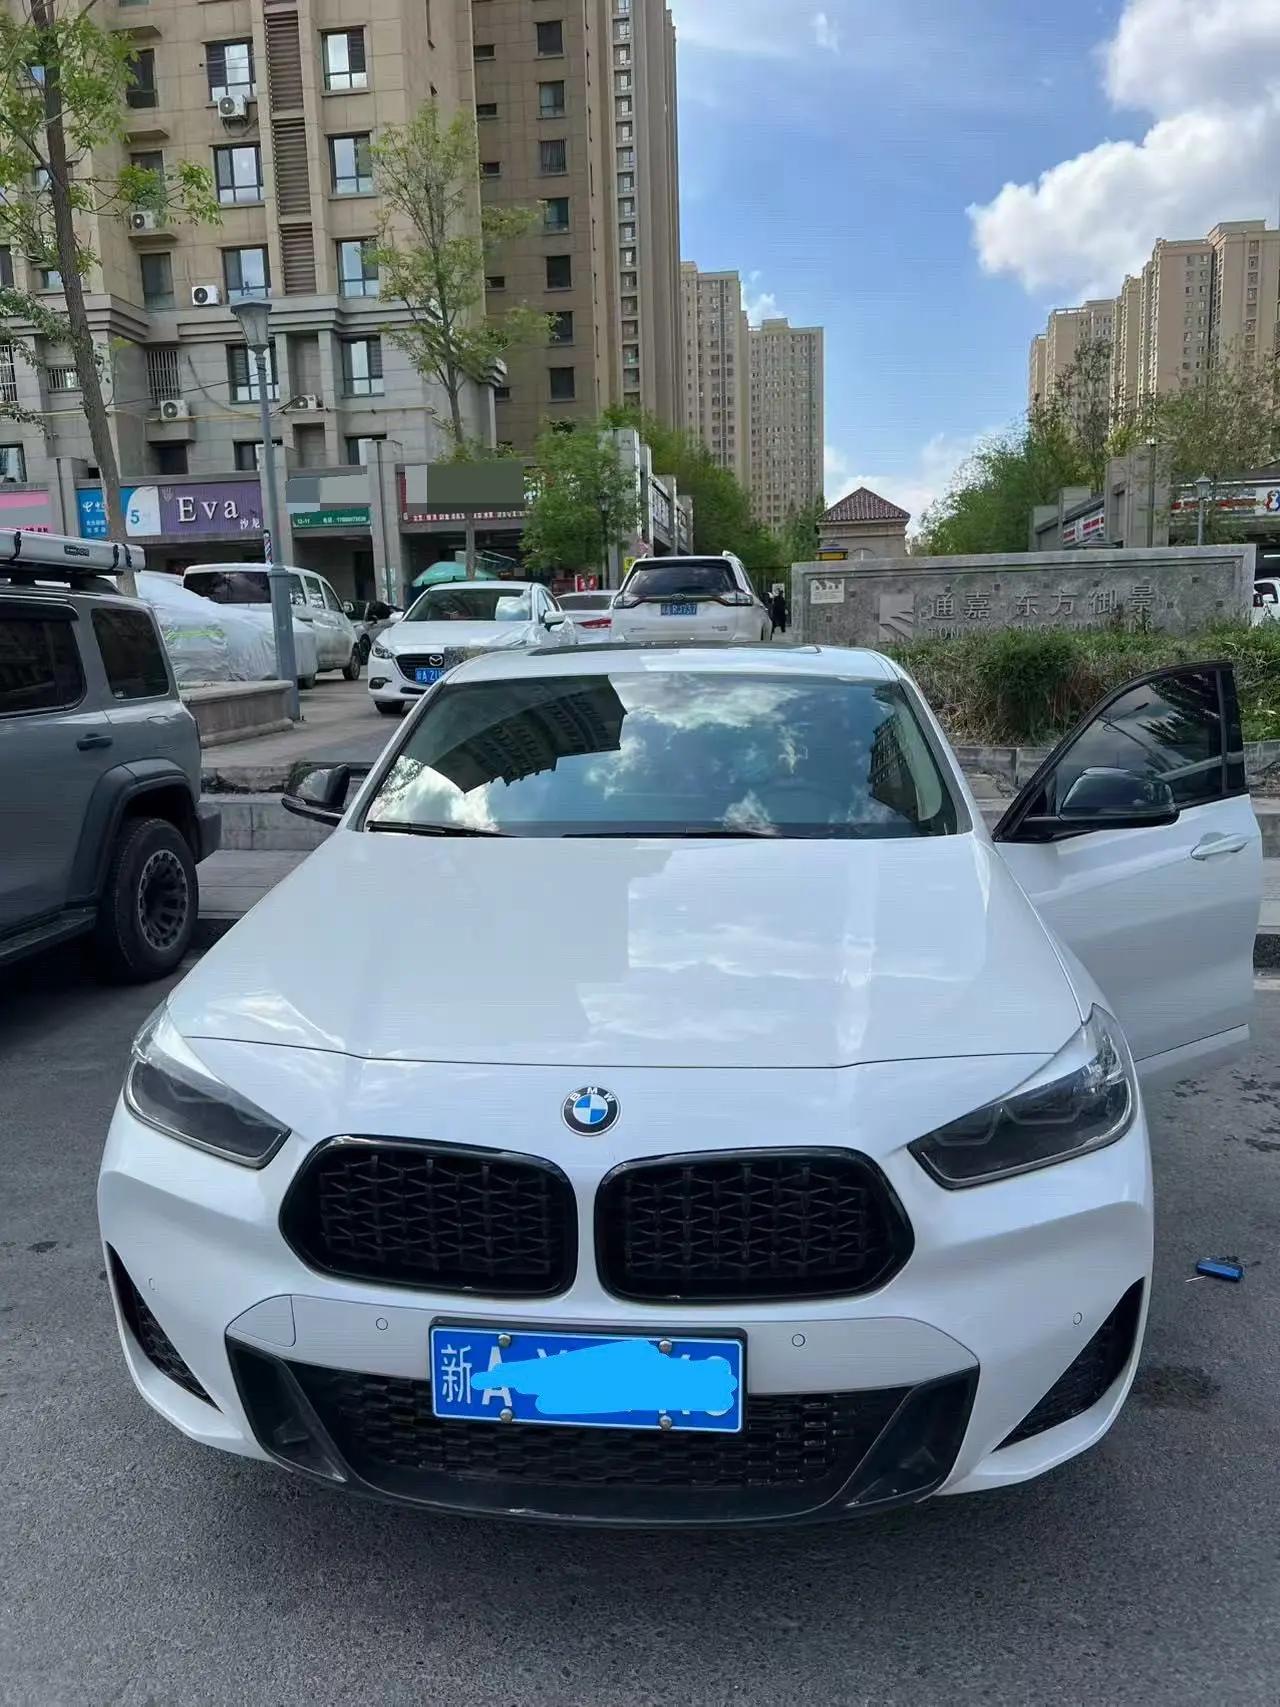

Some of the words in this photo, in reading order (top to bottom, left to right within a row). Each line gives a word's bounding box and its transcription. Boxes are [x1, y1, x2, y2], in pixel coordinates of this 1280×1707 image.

[176, 496, 239, 522] Eva
[920, 586, 992, 620] 通嘉
[1014, 583, 1155, 617] 东方御景
[570, 1087, 615, 1102] BMW
